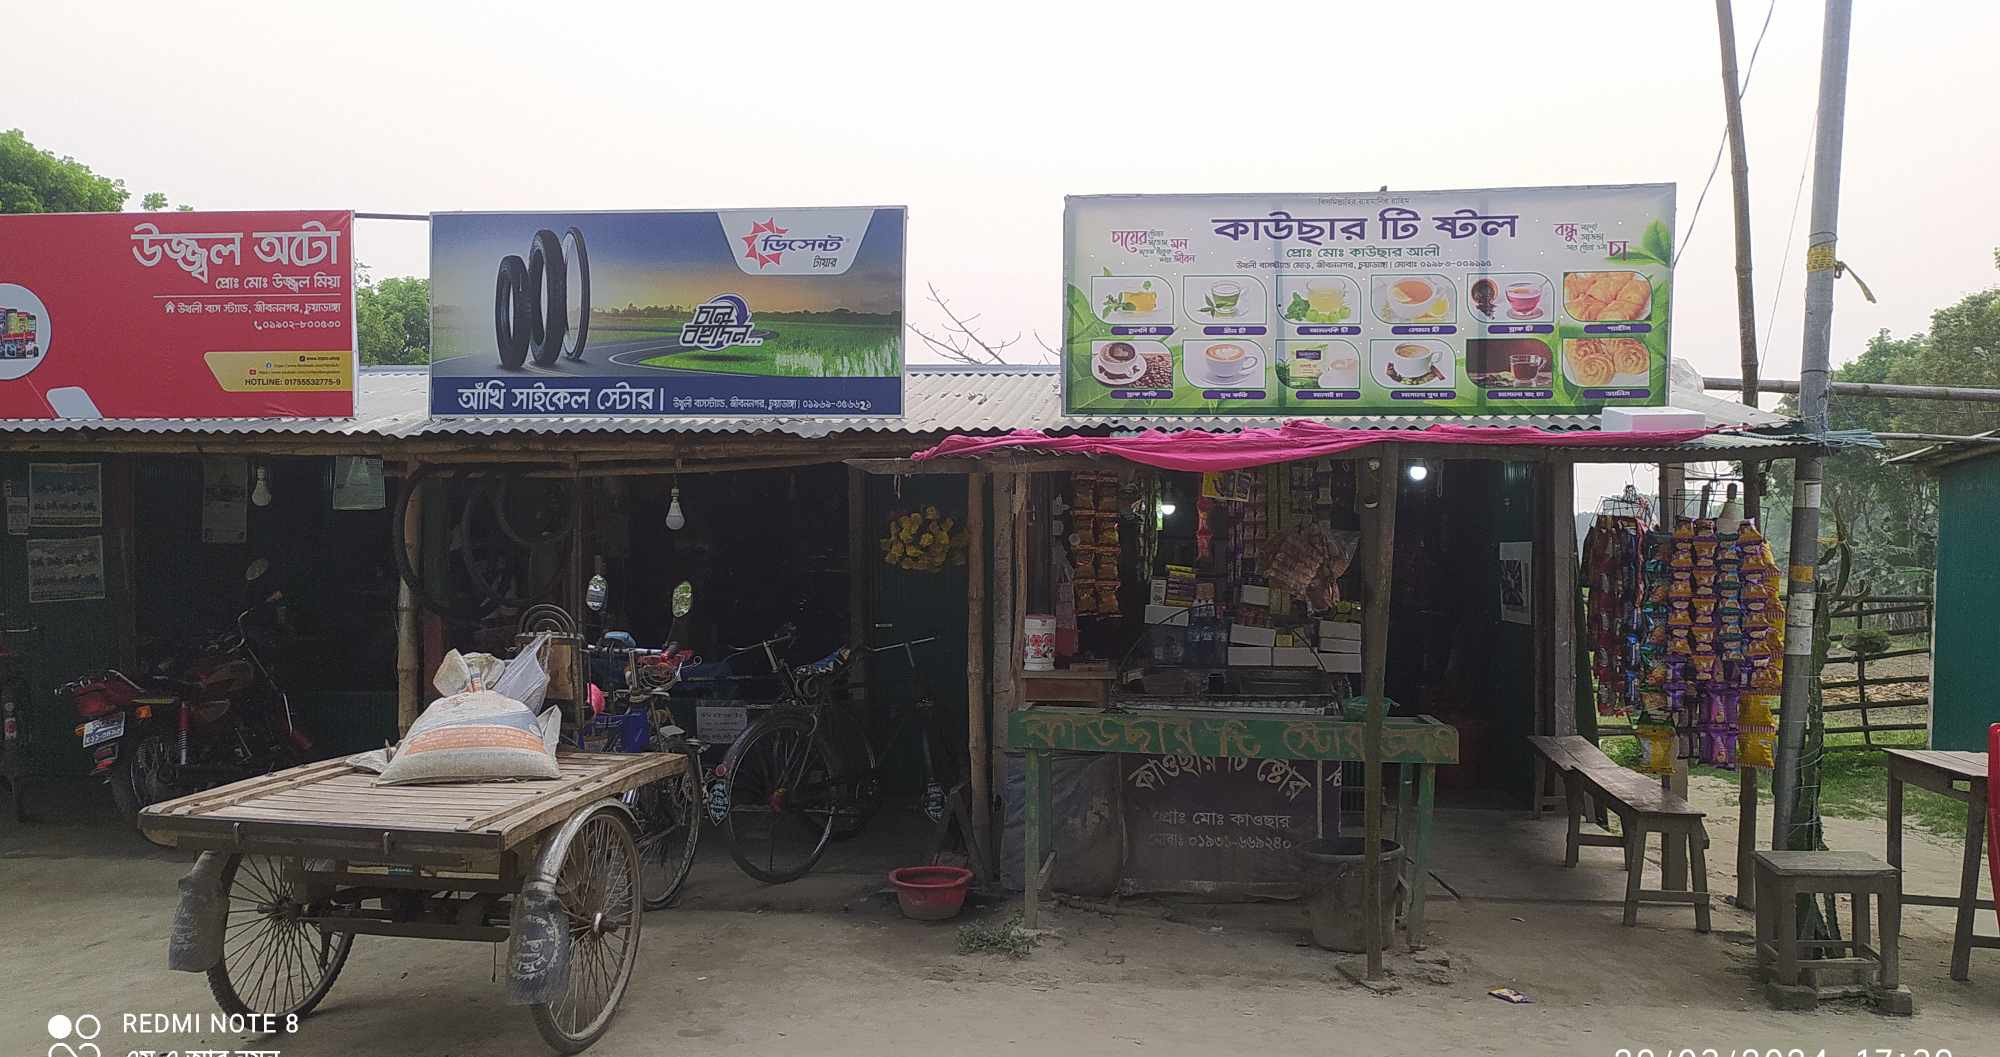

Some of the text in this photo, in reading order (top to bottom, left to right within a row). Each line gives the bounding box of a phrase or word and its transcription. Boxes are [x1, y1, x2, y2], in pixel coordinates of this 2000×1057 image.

[1211, 211, 1368, 246] কাউছার
[1379, 207, 1421, 241] টি
[1553, 223, 1579, 244] বন্ধু
[130, 220, 342, 285] উজ্জ্বল অটো
[761, 234, 844, 252] ডিসেন্ট
[1286, 244, 1440, 260] প্রোঃ মোঃ কাউছার আলী
[1607, 240, 1630, 261] চা
[812, 255, 838, 269] টায়ার
[215, 272, 341, 293] প্রোঃ মোঃ উজ্জ্বল মিয়া
[245, 378, 283, 387] HOTLINE:
[457, 379, 655, 413] আঁখি সাইকেল স্টোর
[1192, 811, 1225, 827] মোঃ
[1229, 812, 1292, 833] কাওছার
